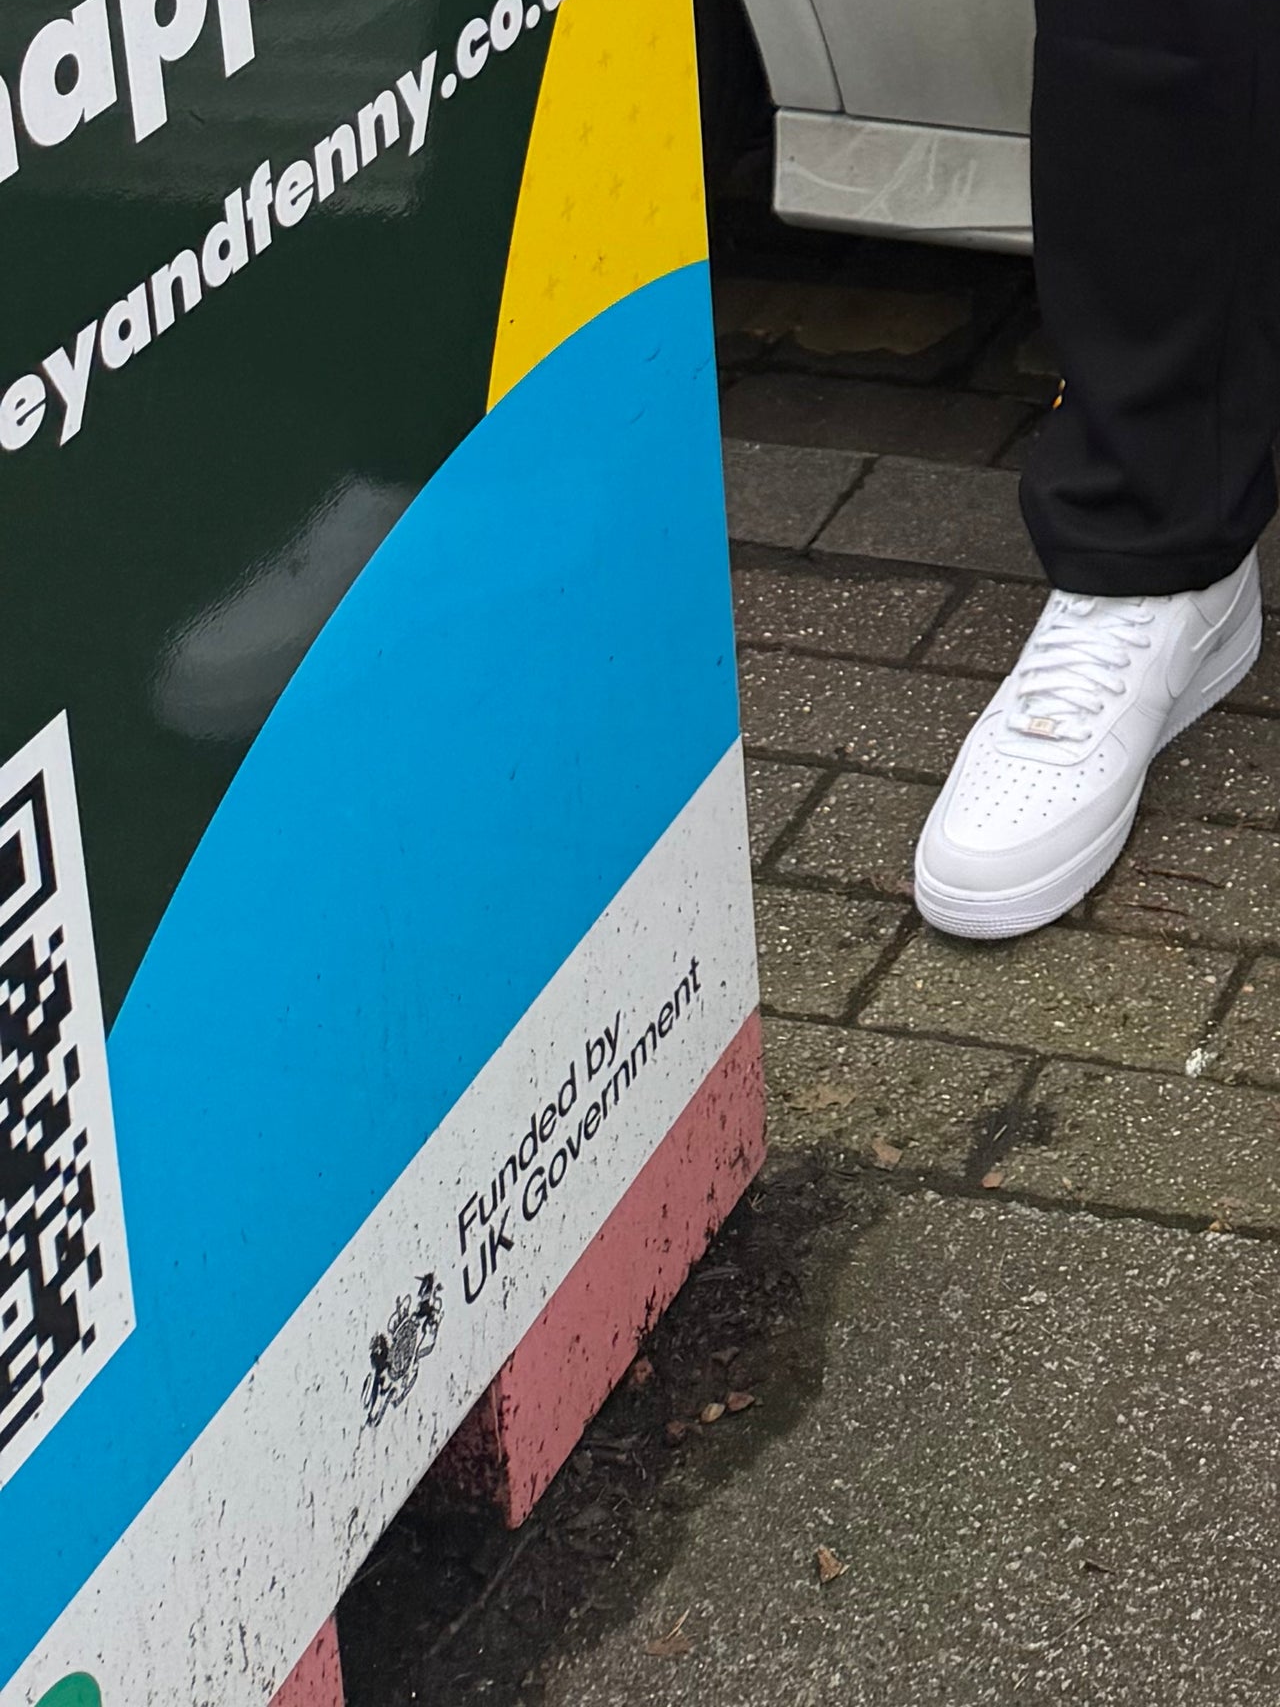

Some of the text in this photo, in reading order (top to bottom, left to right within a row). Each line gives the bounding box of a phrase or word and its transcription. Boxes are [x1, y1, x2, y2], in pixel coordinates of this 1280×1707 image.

[458, 1010, 621, 1256] Funded by
[462, 956, 702, 1305] UK Government
